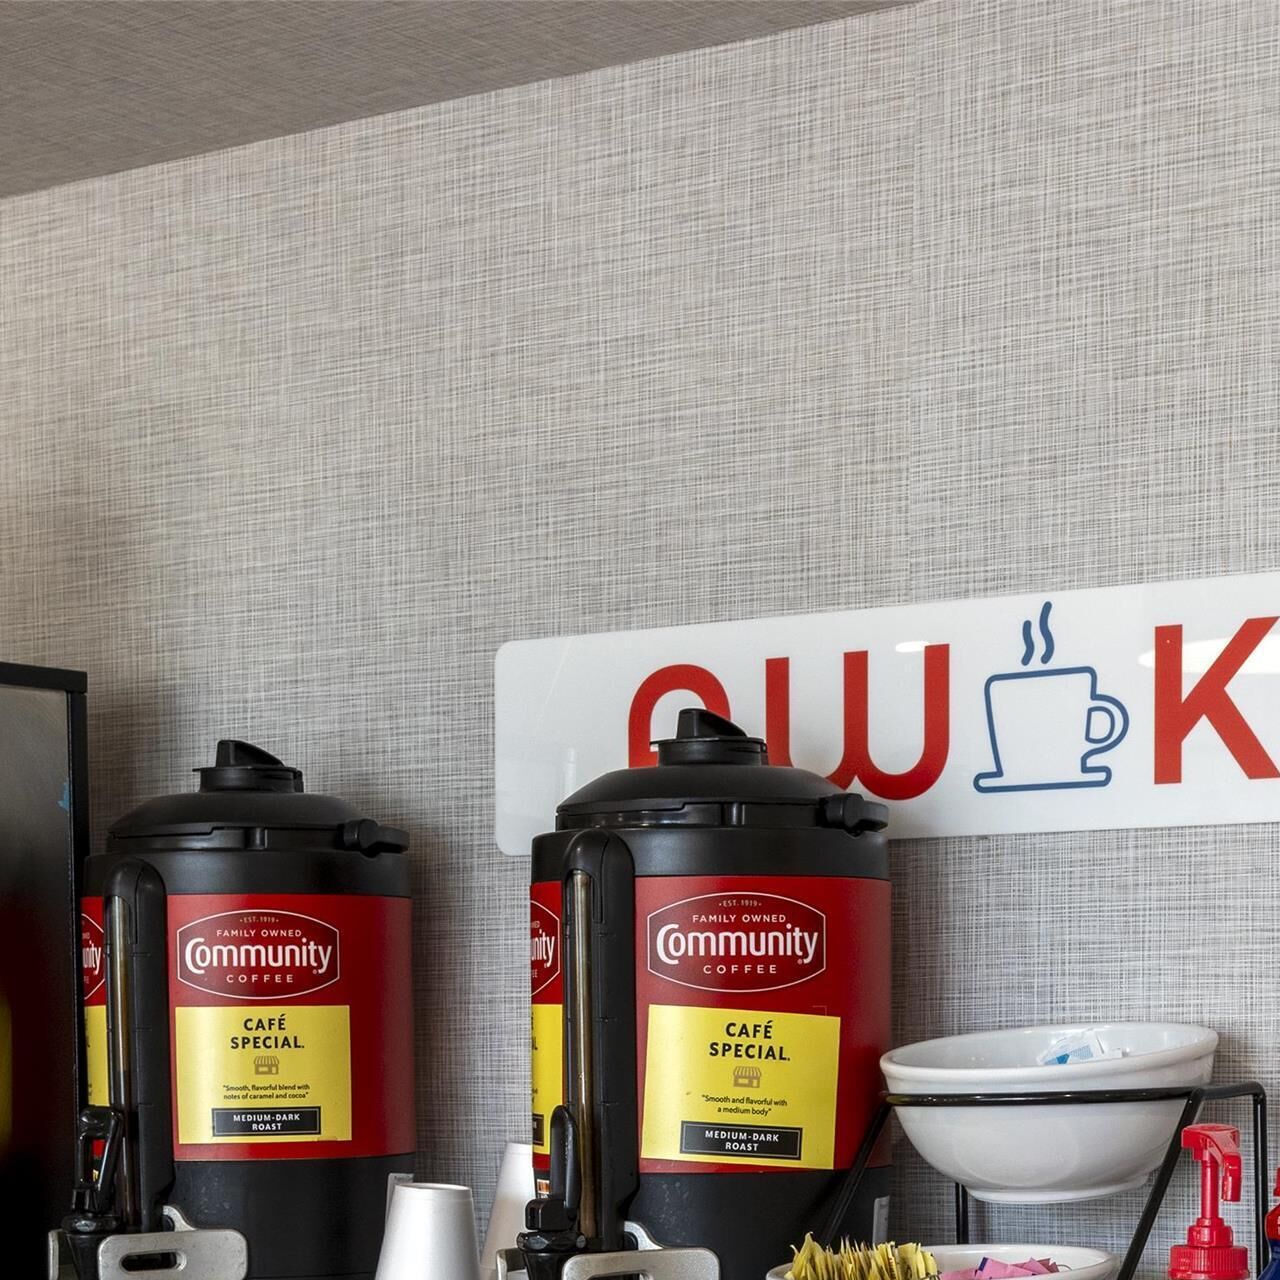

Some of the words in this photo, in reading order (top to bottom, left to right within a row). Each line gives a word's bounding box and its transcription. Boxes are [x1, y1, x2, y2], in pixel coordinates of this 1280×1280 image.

[692, 914, 736, 923] FAMILY
[742, 914, 786, 922] OWNED
[656, 923, 818, 964] Community
[185, 937, 332, 974] Community
[703, 964, 777, 974] COFFEE
[226, 974, 293, 983] COFFEE
[244, 1013, 286, 1031] CAFÉ
[726, 1020, 773, 1039] CAFÉ
[746, 1097, 772, 1106] flavorful
[774, 1098, 788, 1106] with
[723, 1106, 750, 1114] medium
[233, 1114, 300, 1122] MEDIUM-DARK
[705, 1130, 779, 1142] MEDIUM-DARK
[725, 1142, 758, 1151] ROAST
